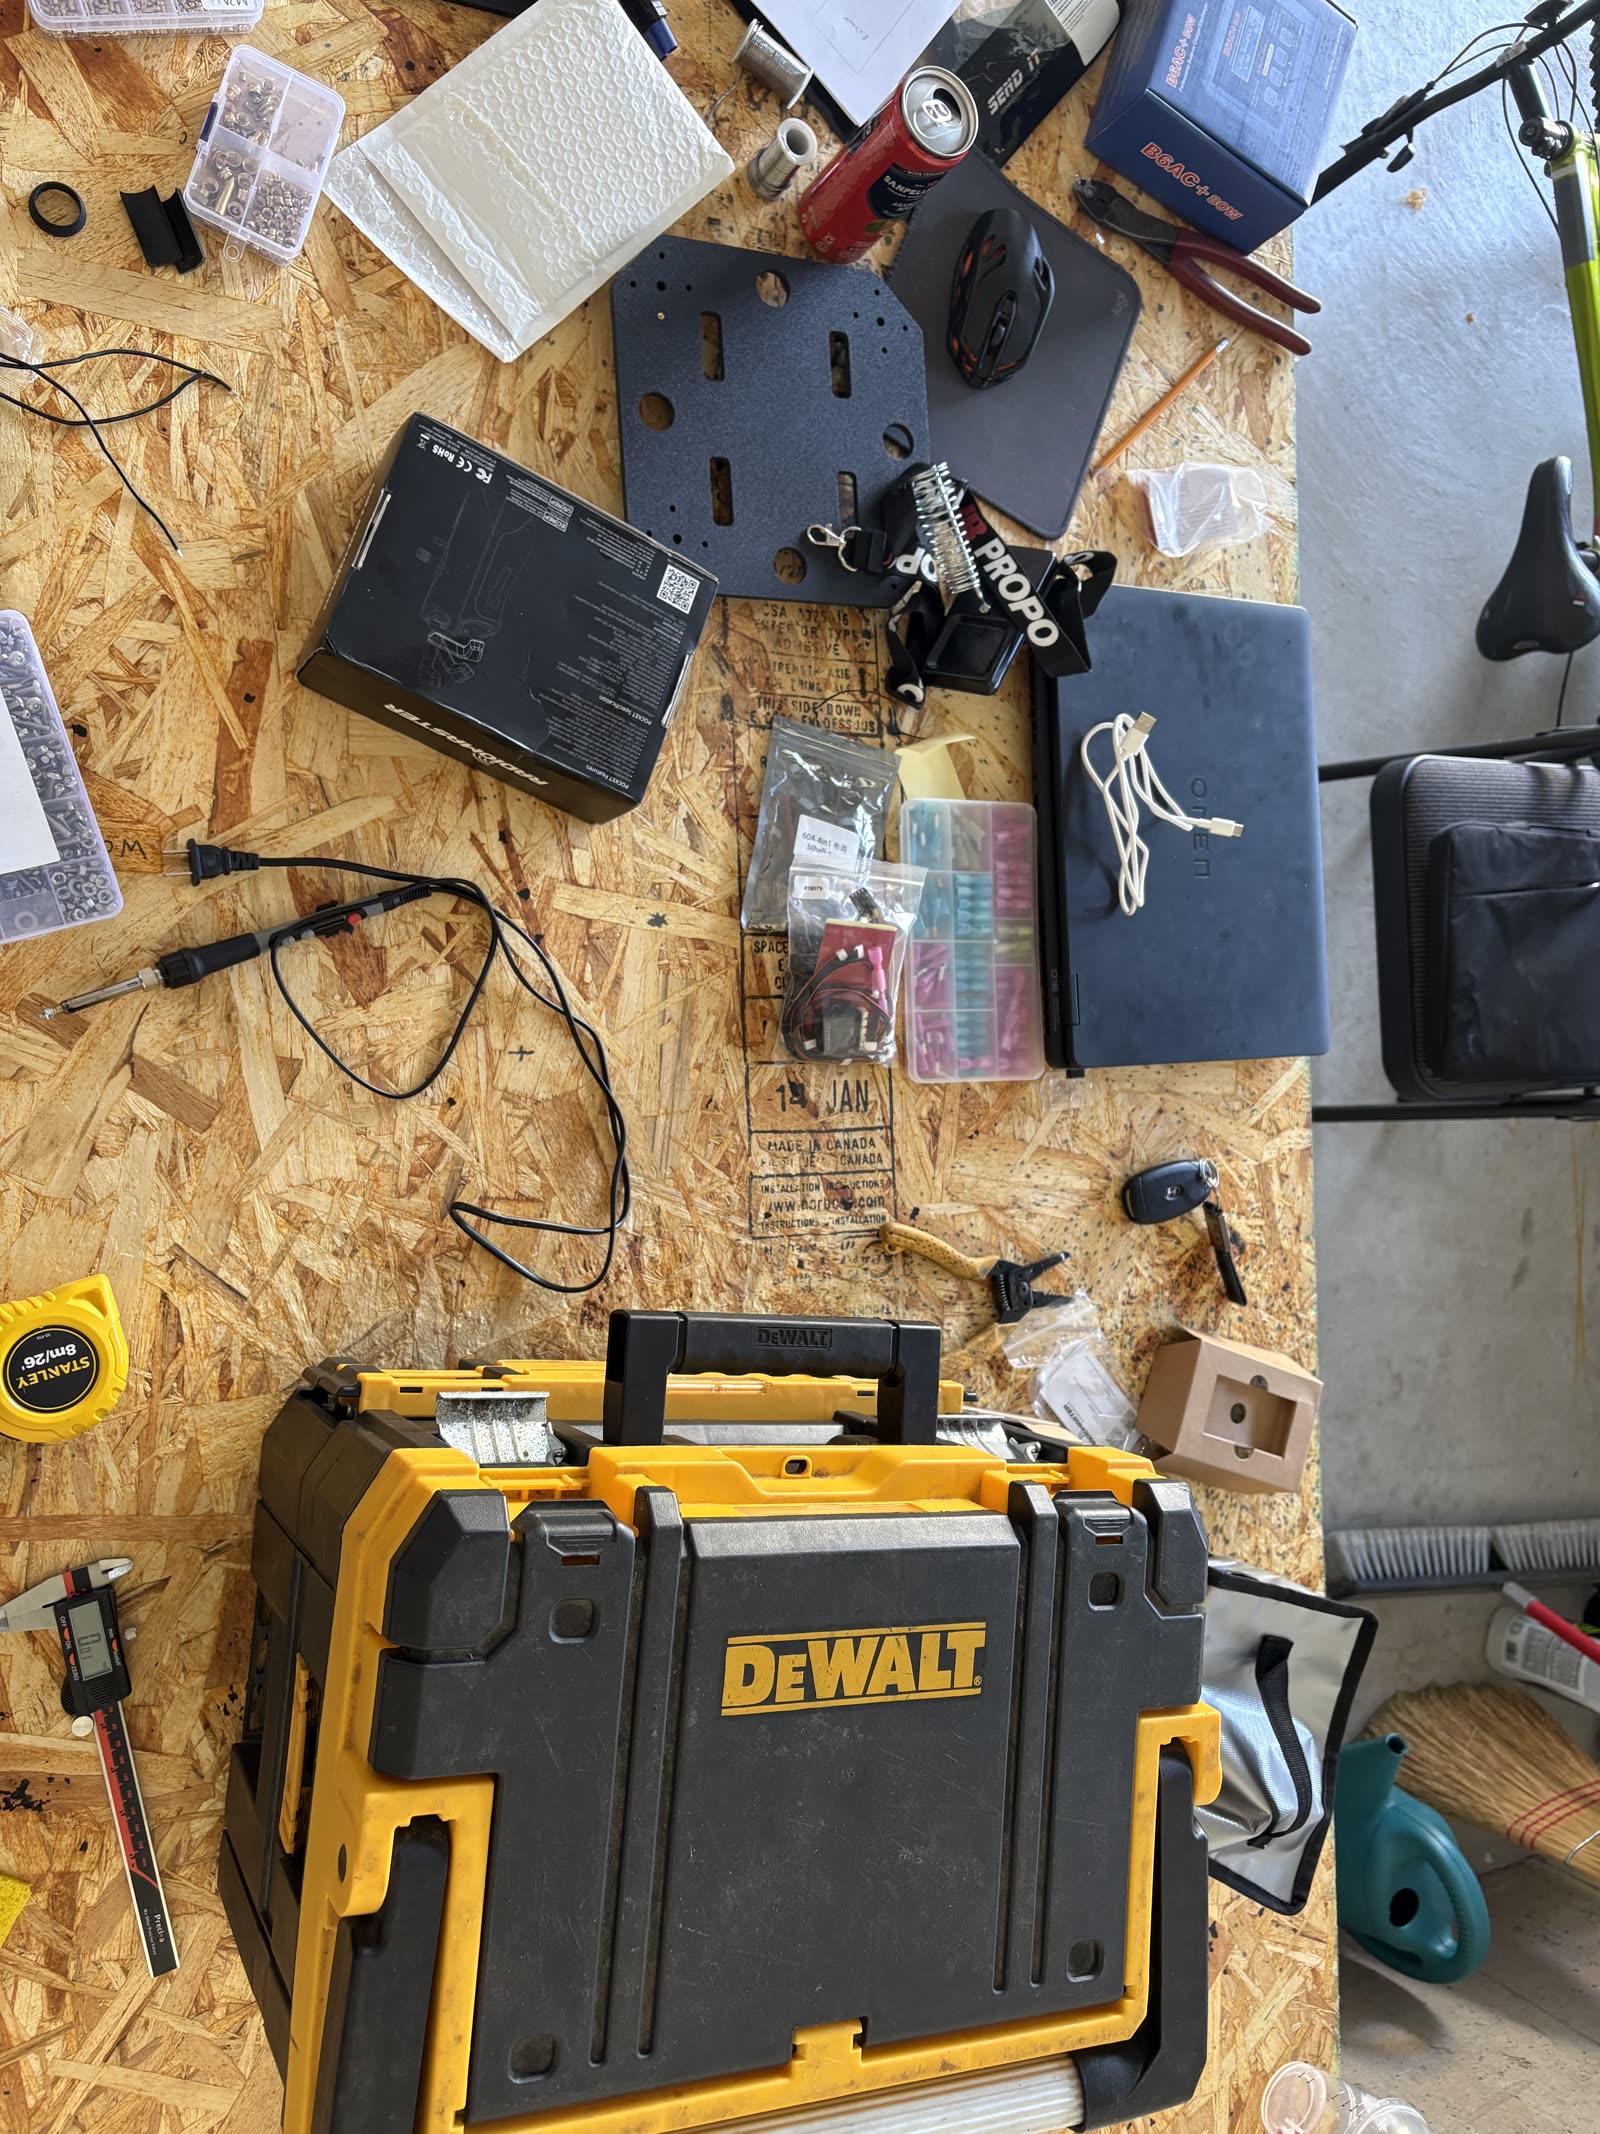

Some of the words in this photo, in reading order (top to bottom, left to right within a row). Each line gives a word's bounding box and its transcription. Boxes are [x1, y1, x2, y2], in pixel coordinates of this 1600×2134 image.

[987, 69, 1024, 116] SEND
[1140, 142, 1209, 197] B6AC+
[1206, 194, 1244, 220] 80W
[430, 442, 455, 463] RoHS
[974, 538, 1060, 647] PROPO
[597, 692, 632, 716] Specification
[791, 698, 819, 714] SIDE
[826, 703, 862, 718] DOWN
[631, 710, 653, 726] POCKET
[384, 701, 550, 788] RADIOMASTER
[584, 763, 609, 780] Features
[607, 774, 630, 790] POCKET
[802, 831, 816, 843] 60A
[817, 836, 832, 848] 4in1
[753, 940, 788, 954] SPACE
[830, 1079, 869, 1114] JAN
[767, 1140, 802, 1152] MADE
[808, 1139, 821, 1151] IN
[826, 1136, 876, 1151] CANADA
[839, 1152, 884, 1167] CANADA
[756, 1327, 829, 1348] DEWALT
[21, 1343, 77, 1371] 8m/26'
[17, 1356, 91, 1390] STANLEY
[66, 1640, 73, 1650] ON
[71, 1665, 80, 1681] ZERO
[723, 1629, 986, 1707] DEWALT
